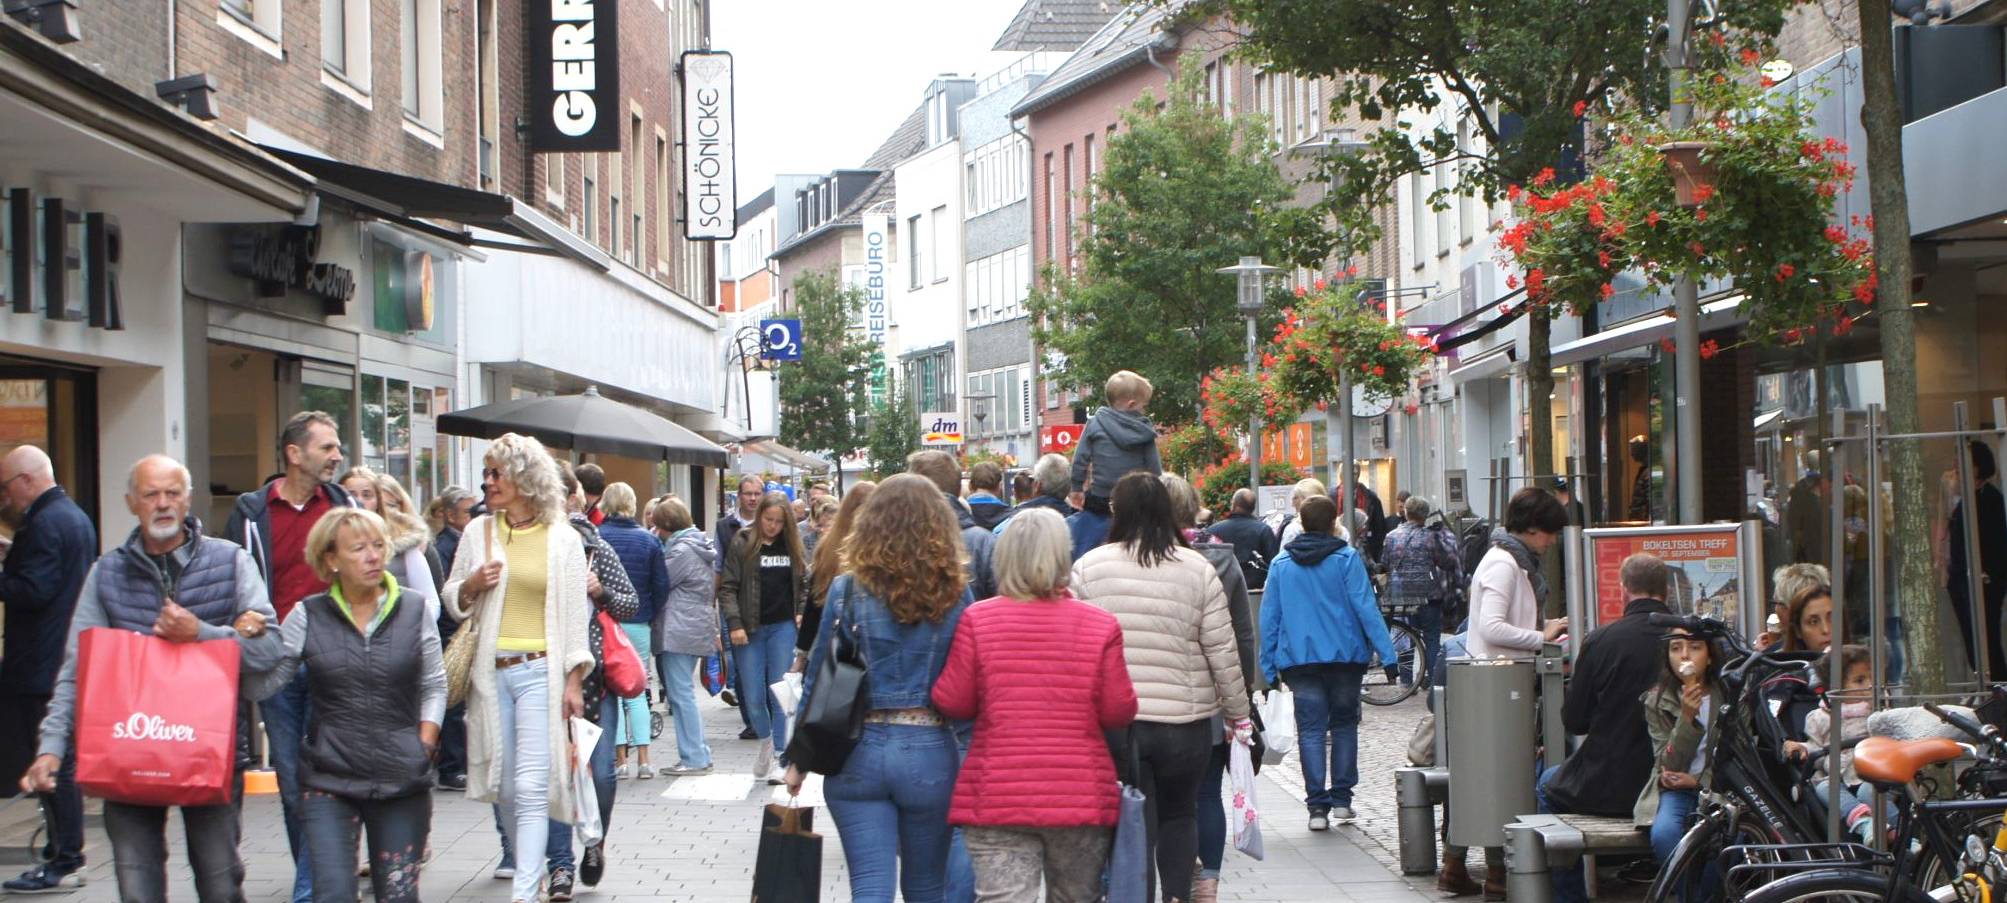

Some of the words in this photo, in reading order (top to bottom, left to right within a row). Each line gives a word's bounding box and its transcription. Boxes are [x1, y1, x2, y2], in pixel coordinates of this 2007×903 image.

[694, 88, 721, 227] SCHÖNICKE
[0, 187, 125, 331] IER
[864, 231, 885, 345] REISEBÜRO
[932, 418, 958, 433] dm
[1699, 539, 1728, 549] TREFF
[113, 712, 197, 742] s.Oliver
[1744, 785, 1784, 829] GAZELLE
